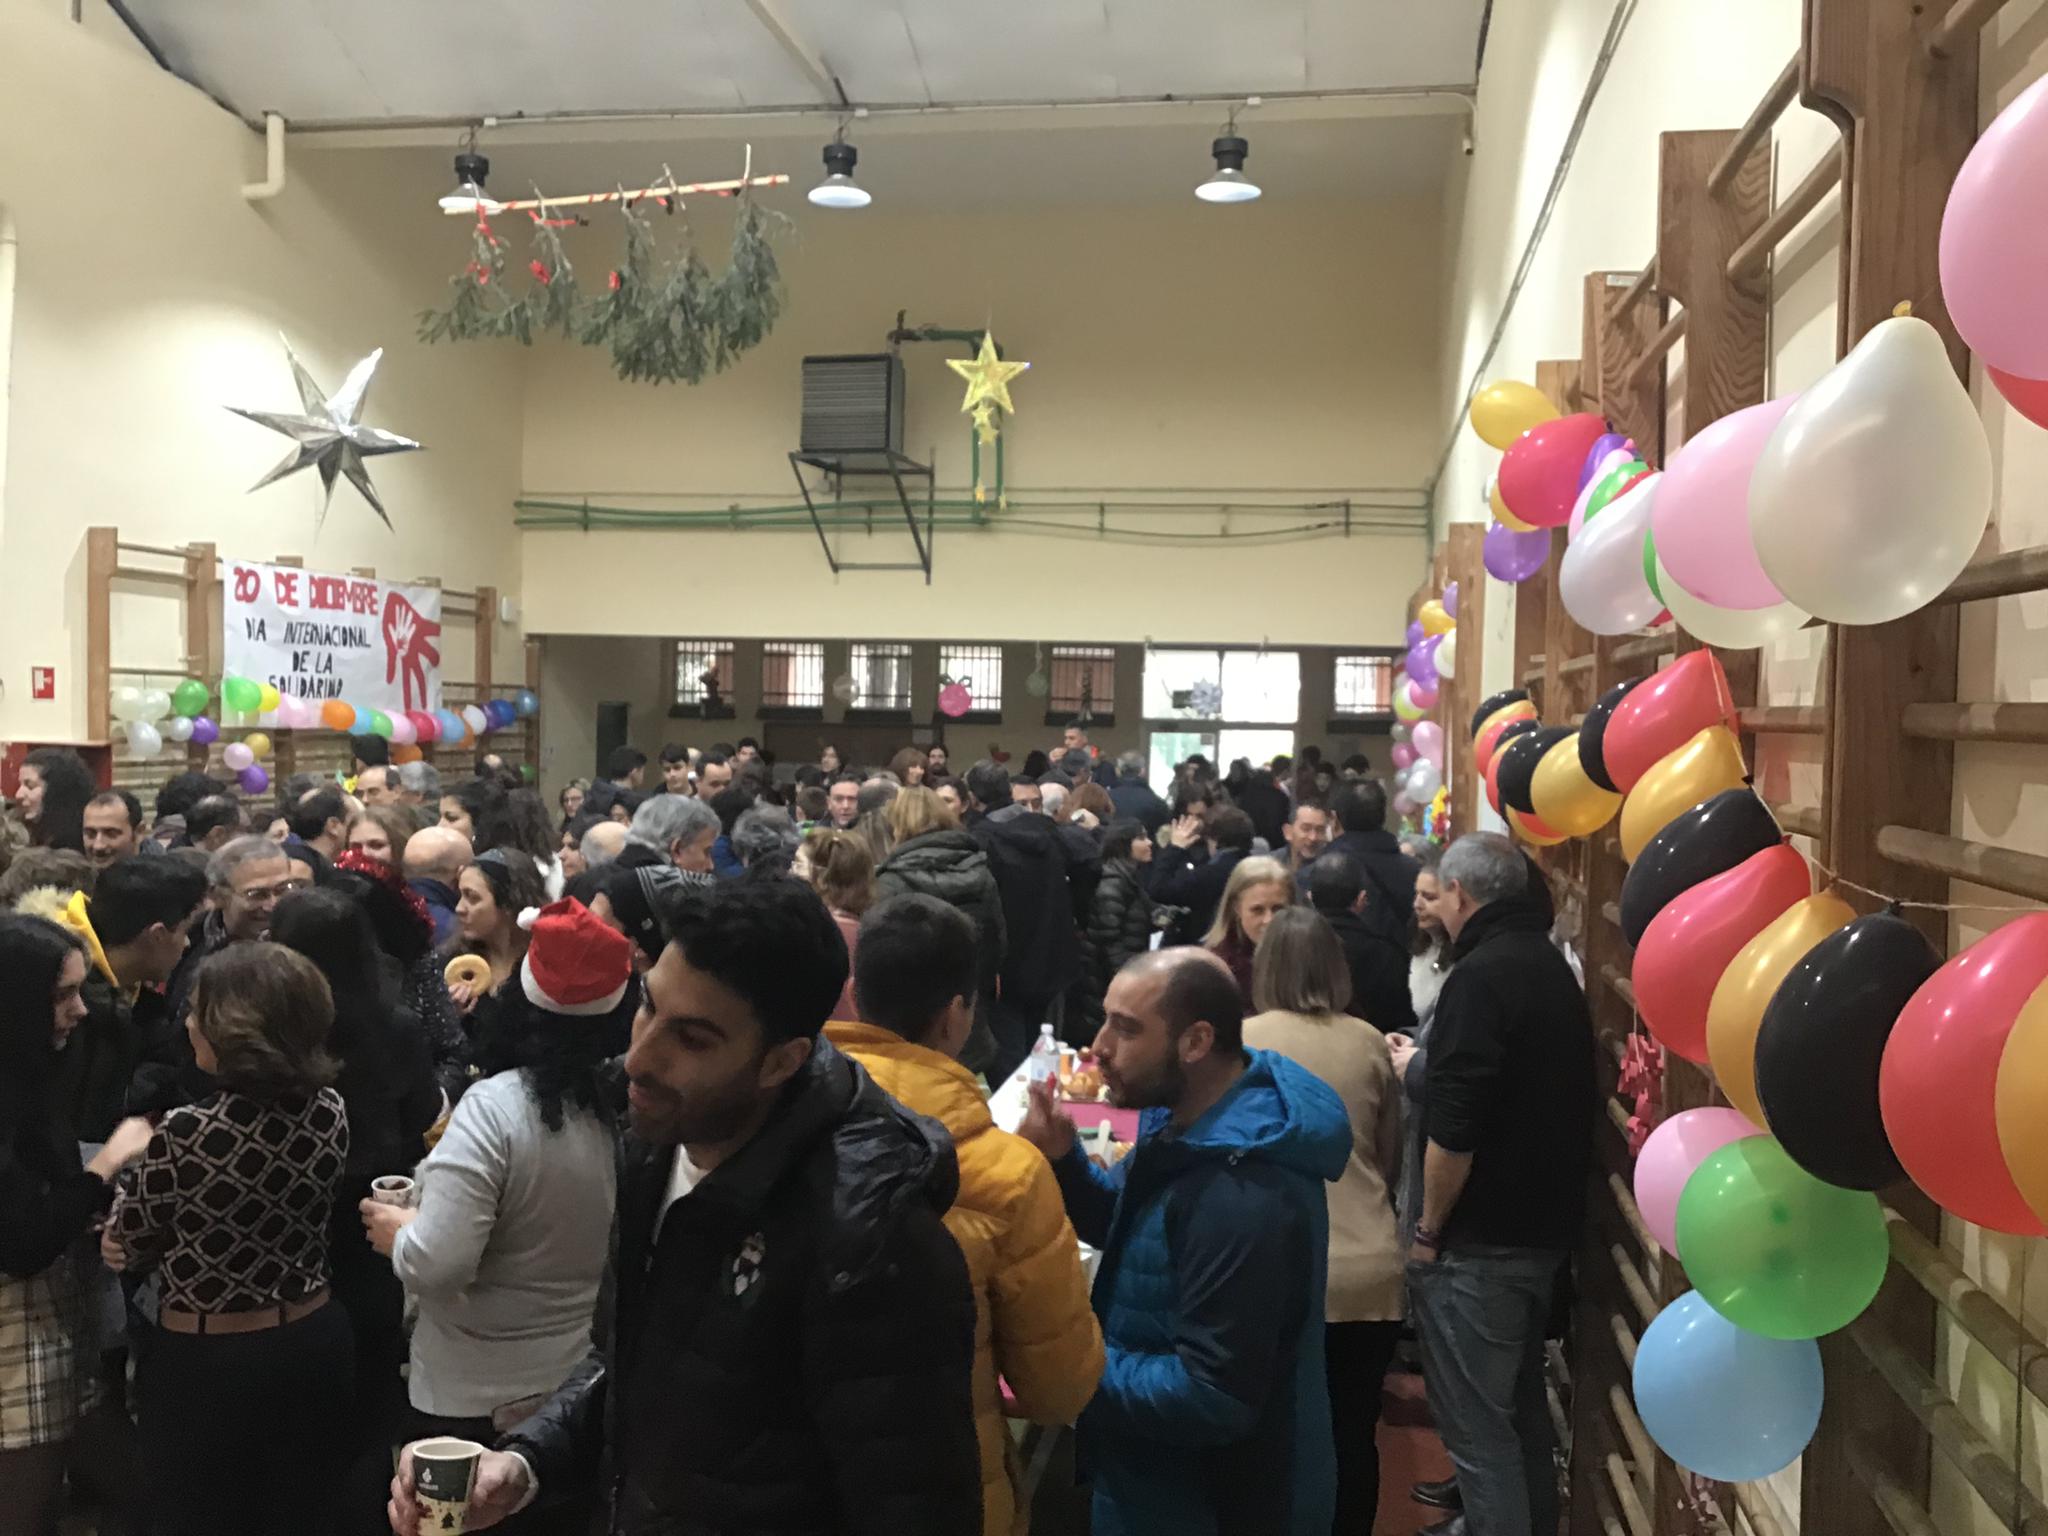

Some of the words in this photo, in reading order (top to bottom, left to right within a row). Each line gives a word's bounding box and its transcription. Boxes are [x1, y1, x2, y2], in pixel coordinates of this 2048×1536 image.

[234, 566, 261, 603] 20
[274, 572, 299, 607] DE
[284, 621, 371, 648] INTERNACIONAL
[292, 651, 310, 672] DE
[315, 651, 332, 674] LA
